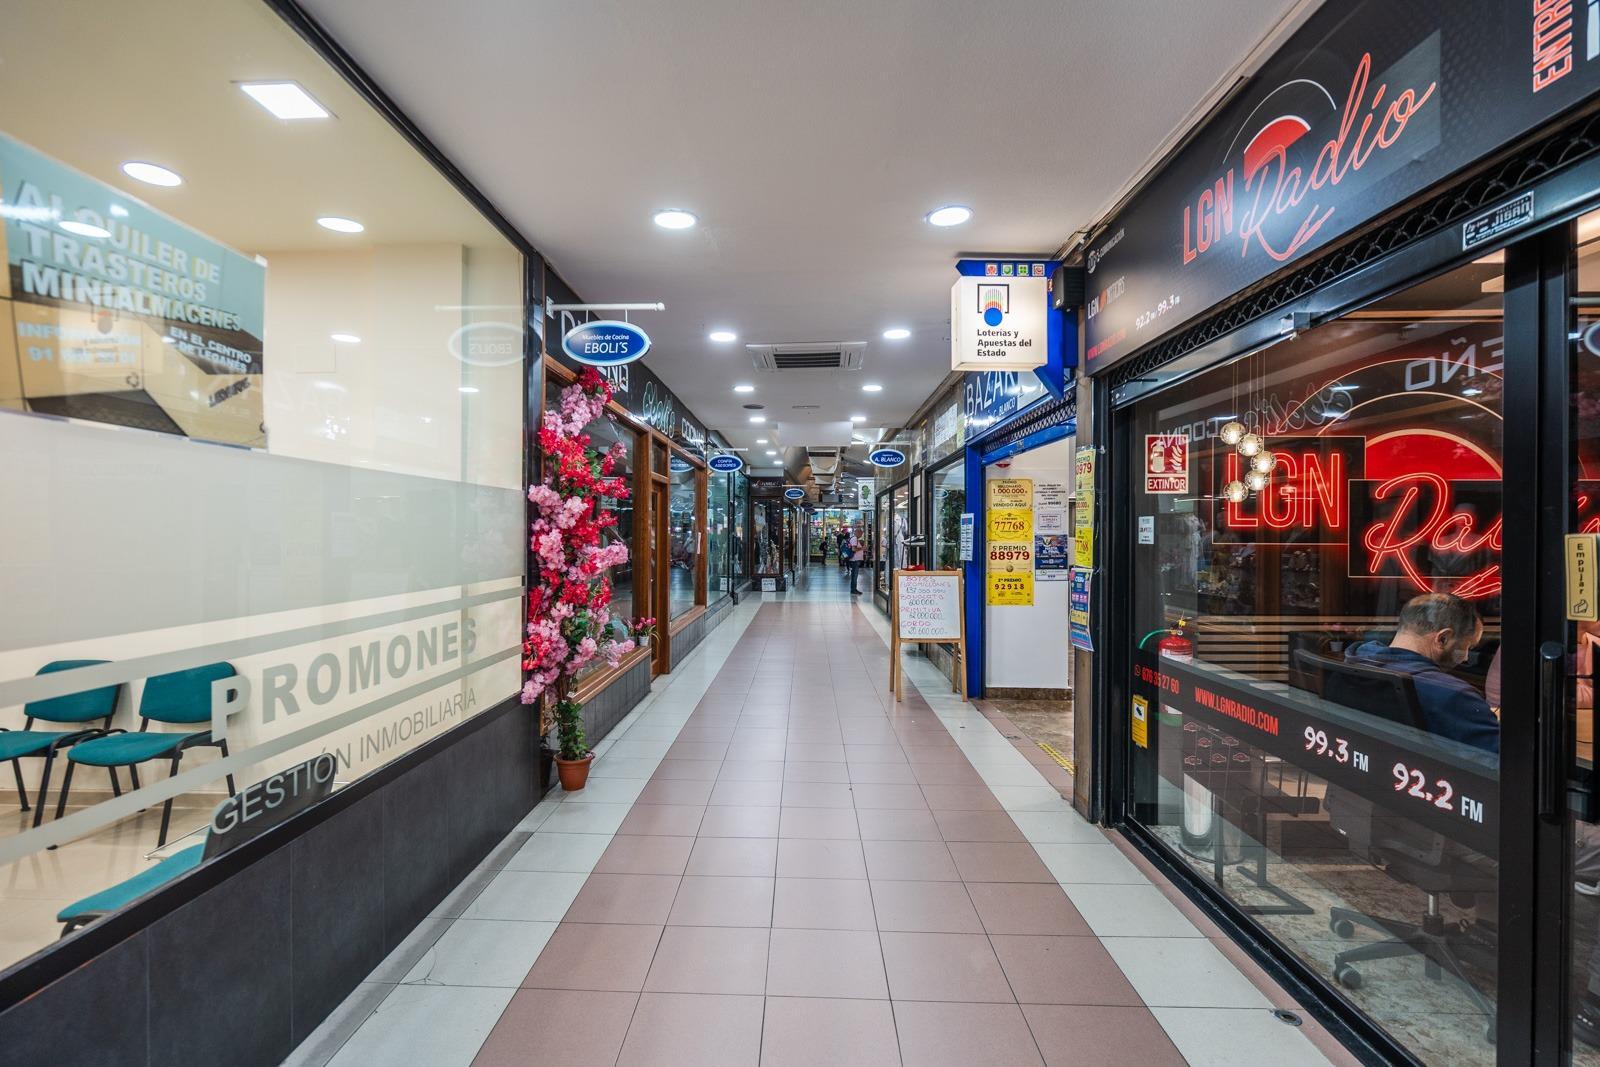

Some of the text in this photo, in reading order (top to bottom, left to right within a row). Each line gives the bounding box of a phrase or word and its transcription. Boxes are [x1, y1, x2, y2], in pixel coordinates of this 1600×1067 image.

[1182, 52, 1437, 266] LGN Radio
[18, 220, 207, 303] TRASTEROS
[192, 252, 221, 285] DE
[20, 260, 242, 331] MINIALMACENES
[207, 340, 253, 364] CENTRO
[584, 341, 629, 354] EBOLI'S
[977, 328, 1019, 339] Loterías y
[977, 338, 1032, 349] Apuestas del
[977, 349, 1006, 357] Estado
[1148, 478, 1186, 490] EXTINTOR
[1227, 452, 1341, 529] LGN
[994, 521, 1025, 531] 77768
[990, 551, 1030, 561] 88979
[1576, 542, 1585, 595] Empujar
[211, 618, 477, 743] PROMONES
[1194, 687, 1279, 736] WWW.LGNRADIO.COM
[209, 688, 476, 835] GESTIÓN INMOBILIARIA
[1304, 725, 1369, 773] 99.3 FM
[1392, 762, 1483, 824] 92.2 FM
